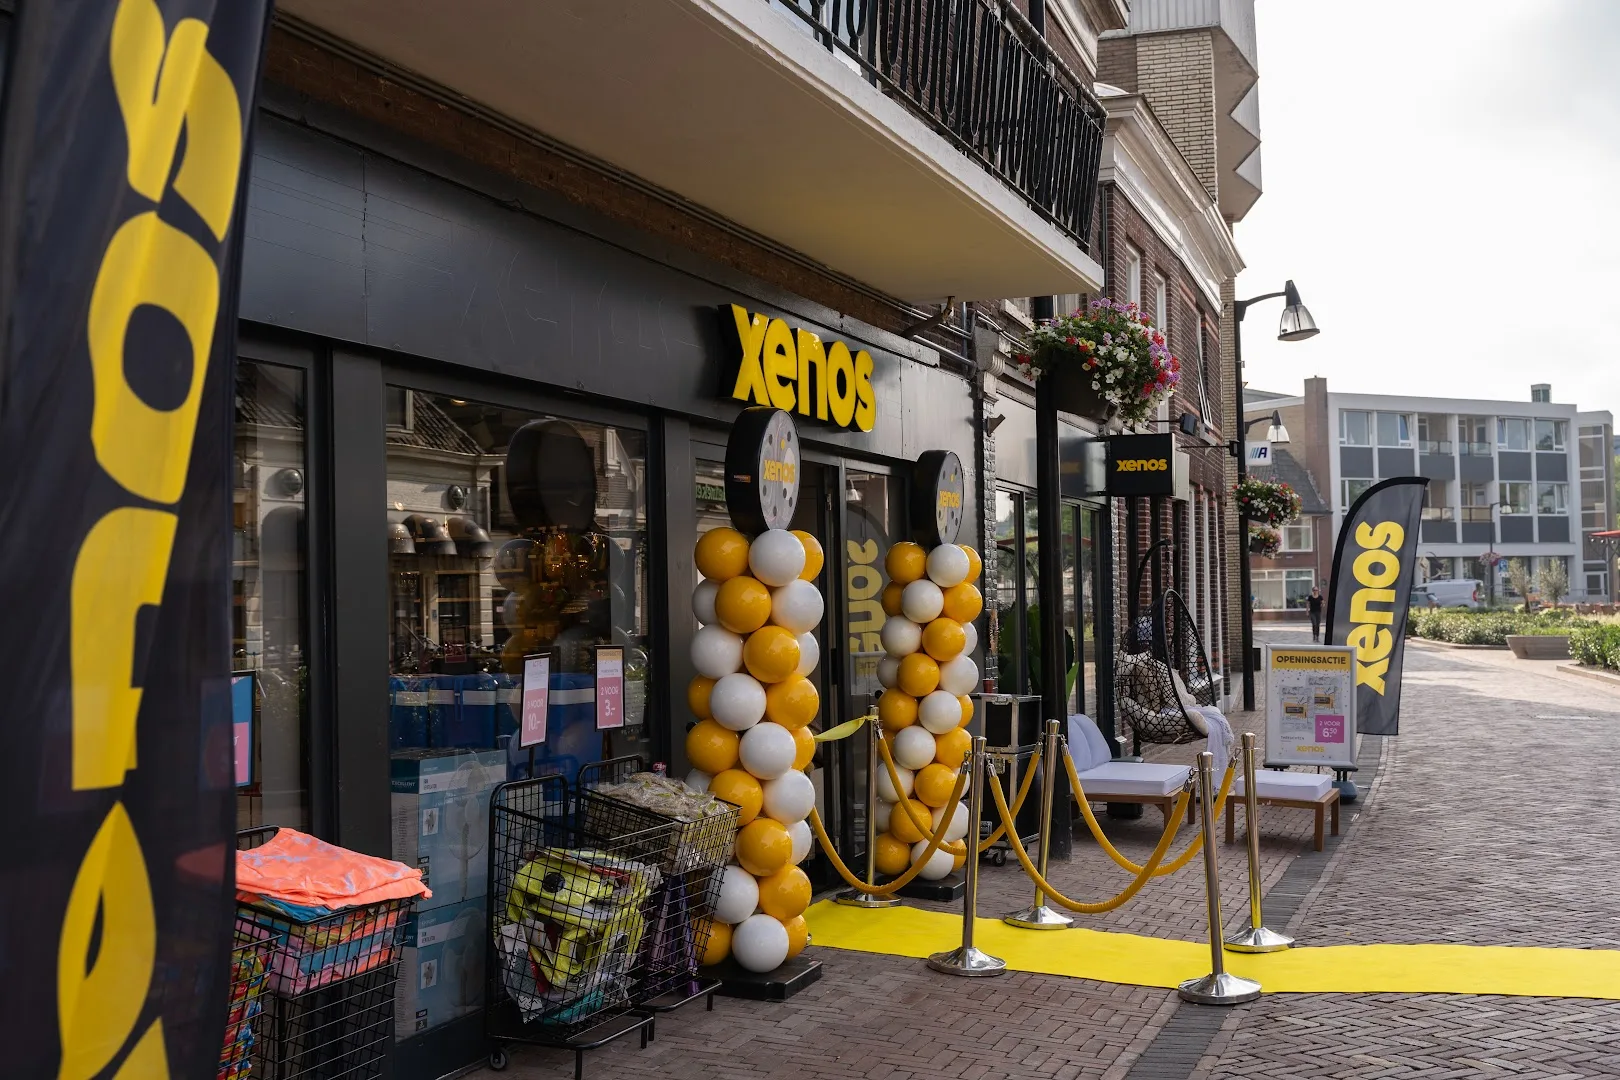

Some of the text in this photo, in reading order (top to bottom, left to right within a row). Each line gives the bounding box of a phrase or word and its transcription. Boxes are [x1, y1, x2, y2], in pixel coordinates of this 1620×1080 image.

[731, 303, 877, 433] xenos
[763, 459, 796, 484] xenos
[1116, 458, 1168, 473] xenos
[939, 489, 961, 509] xenos
[57, 0, 243, 1080] enos
[1346, 520, 1405, 697] xenos
[1276, 655, 1347, 665] OPENINGSACTIE
[600, 687, 619, 696] 2 VOOR
[531, 698, 544, 709] VOOR
[1296, 744, 1326, 753] xenos
